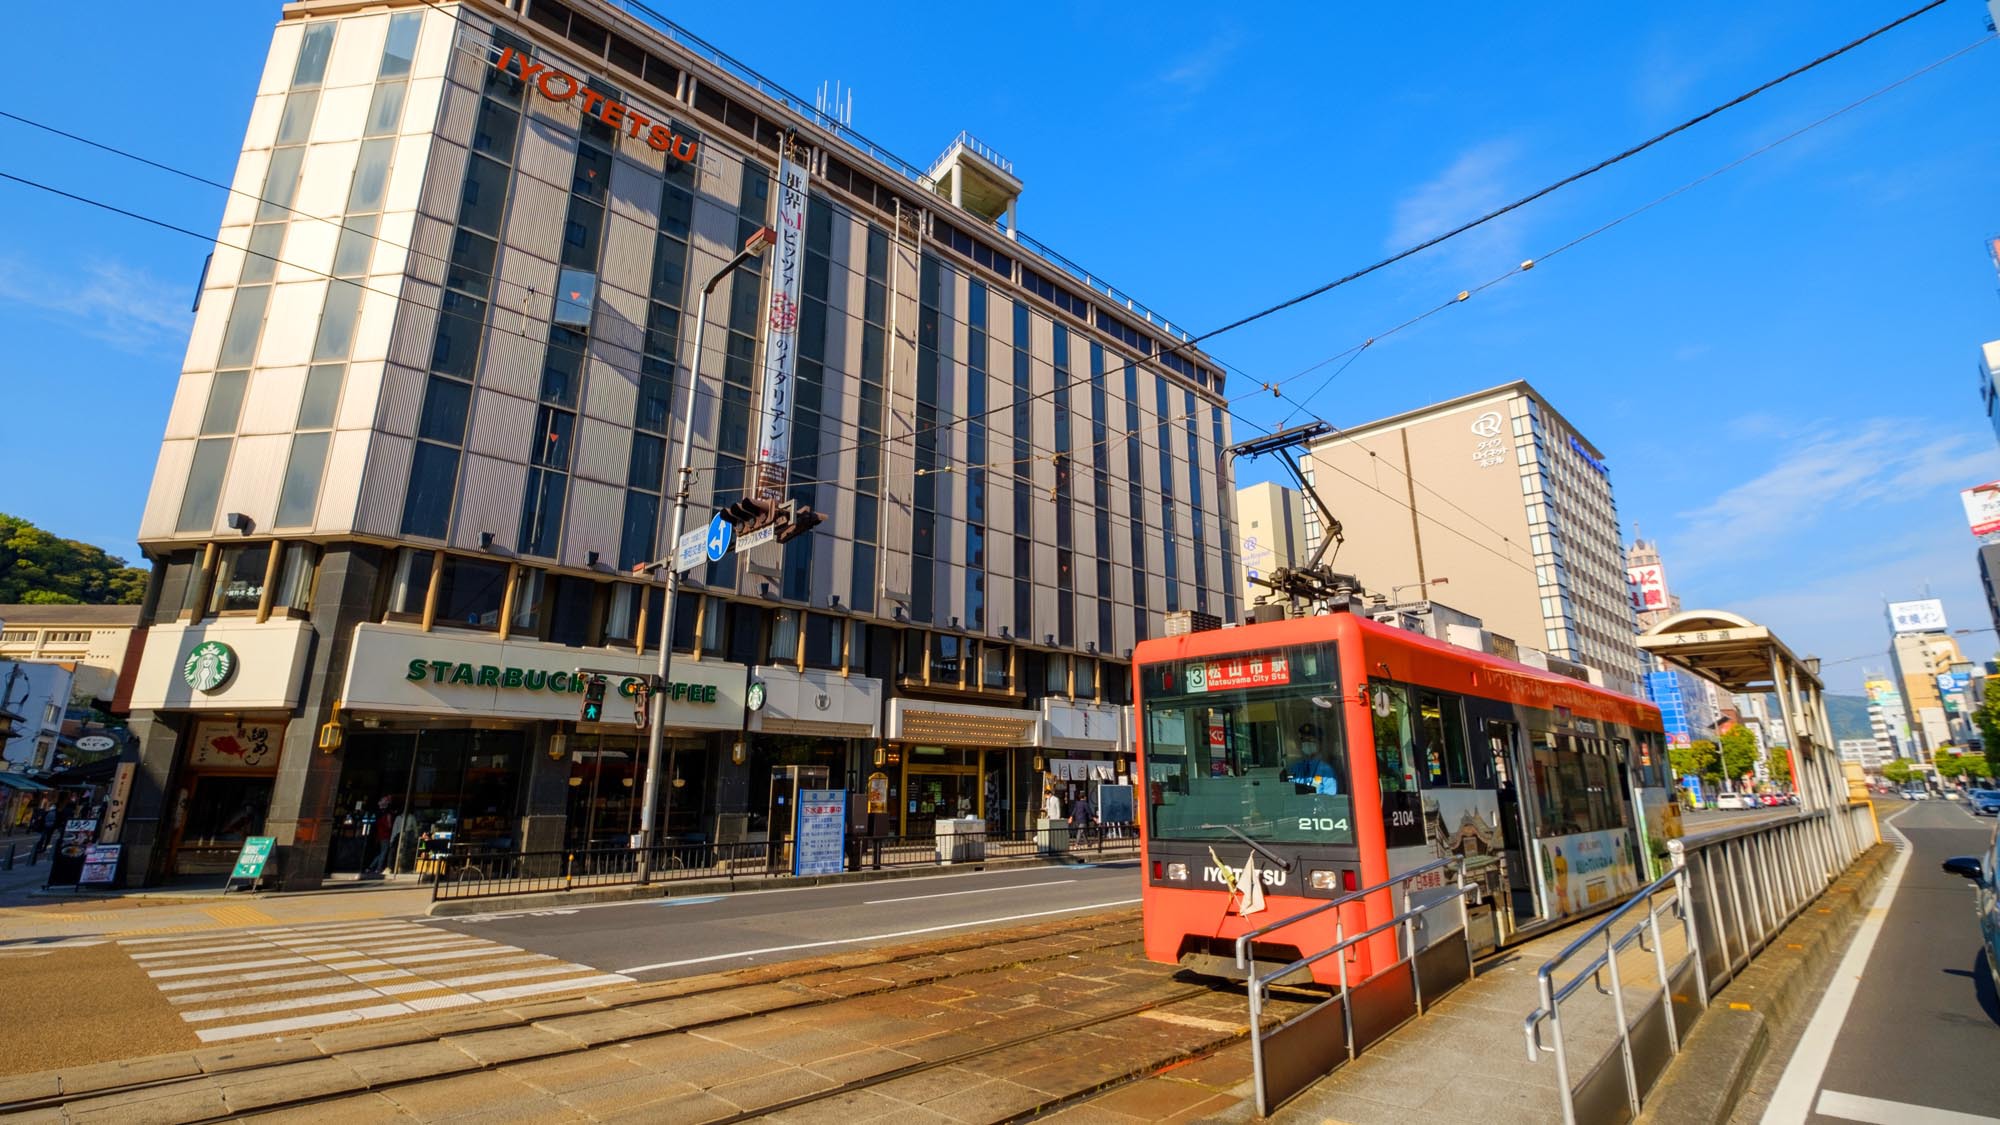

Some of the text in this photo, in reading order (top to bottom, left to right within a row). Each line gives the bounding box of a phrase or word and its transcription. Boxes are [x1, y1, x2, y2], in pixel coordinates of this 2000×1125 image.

[496, 47, 698, 163] IYOTETSU
[769, 340, 788, 440] のイタリアン
[1477, 438, 1501, 450] ダイワ
[1479, 456, 1504, 468] ホテル
[1674, 630, 1731, 644] 大街道
[1192, 656, 1287, 685] 3 松山市駅
[406, 658, 717, 703] STARBUCK CFEE
[1208, 672, 1289, 687] Matsuyama City Sta.
[1298, 818, 1349, 831] 2104
[1393, 810, 1415, 826] 2104
[1416, 871, 1441, 890] 日本郵便
